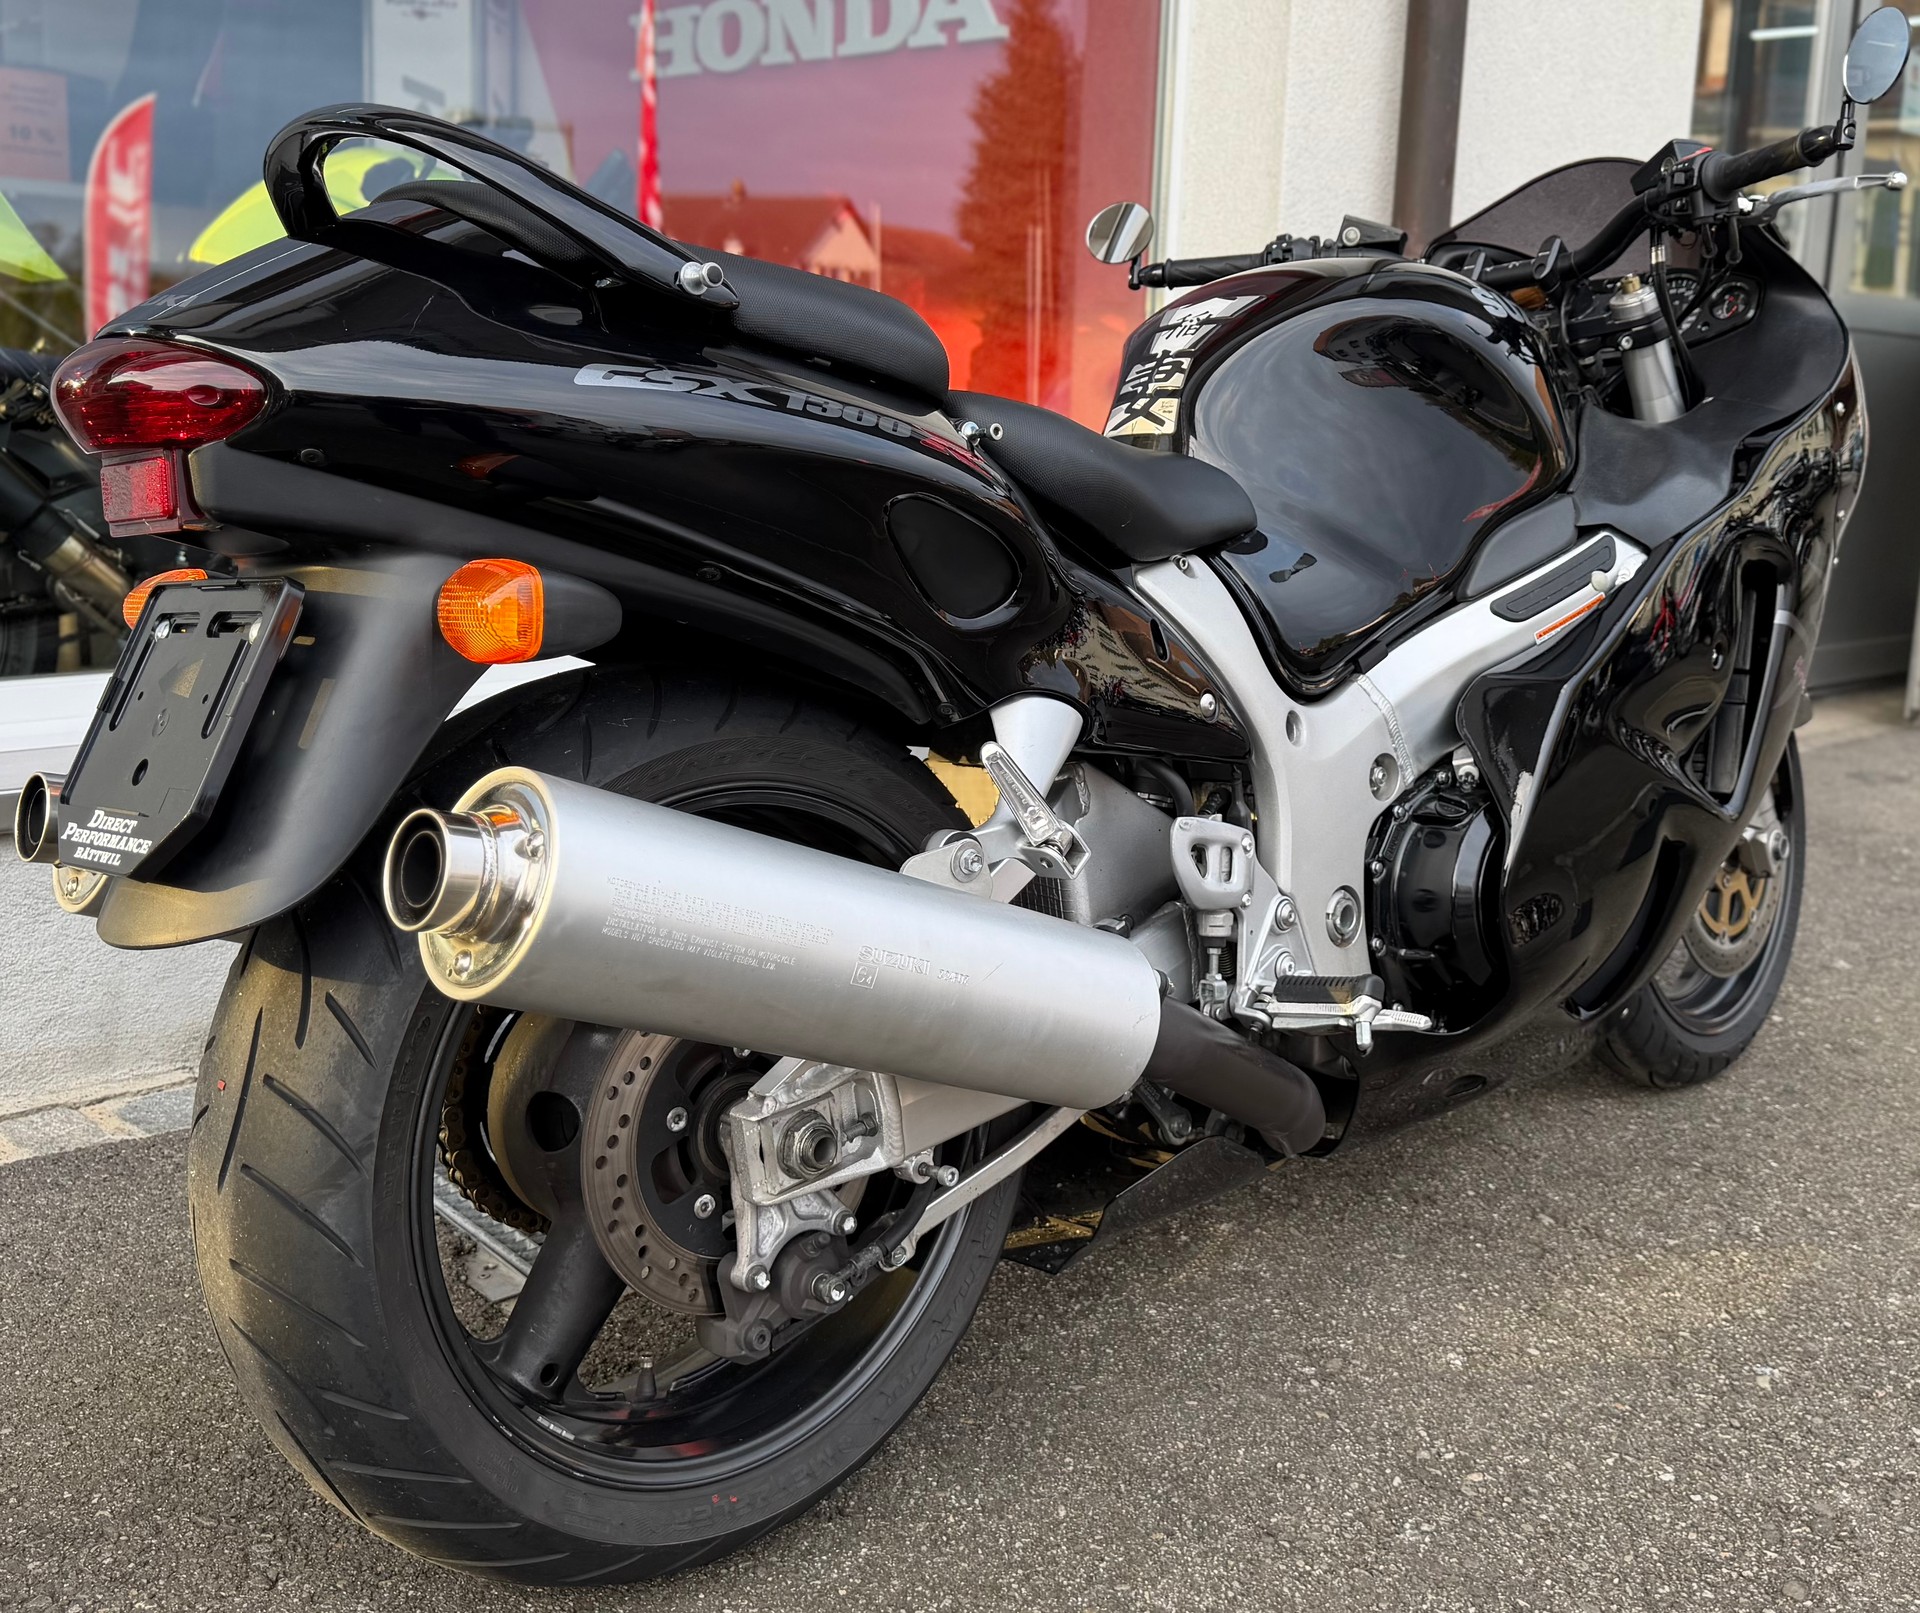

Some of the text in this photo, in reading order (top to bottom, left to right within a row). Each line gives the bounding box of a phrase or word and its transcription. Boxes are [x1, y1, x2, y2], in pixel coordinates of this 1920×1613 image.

[628, 0, 1010, 83] HONDA
[87, 809, 138, 834] DIRECT
[60, 821, 153, 855] PERFORMANCE
[858, 945, 931, 975] SUZUKI
